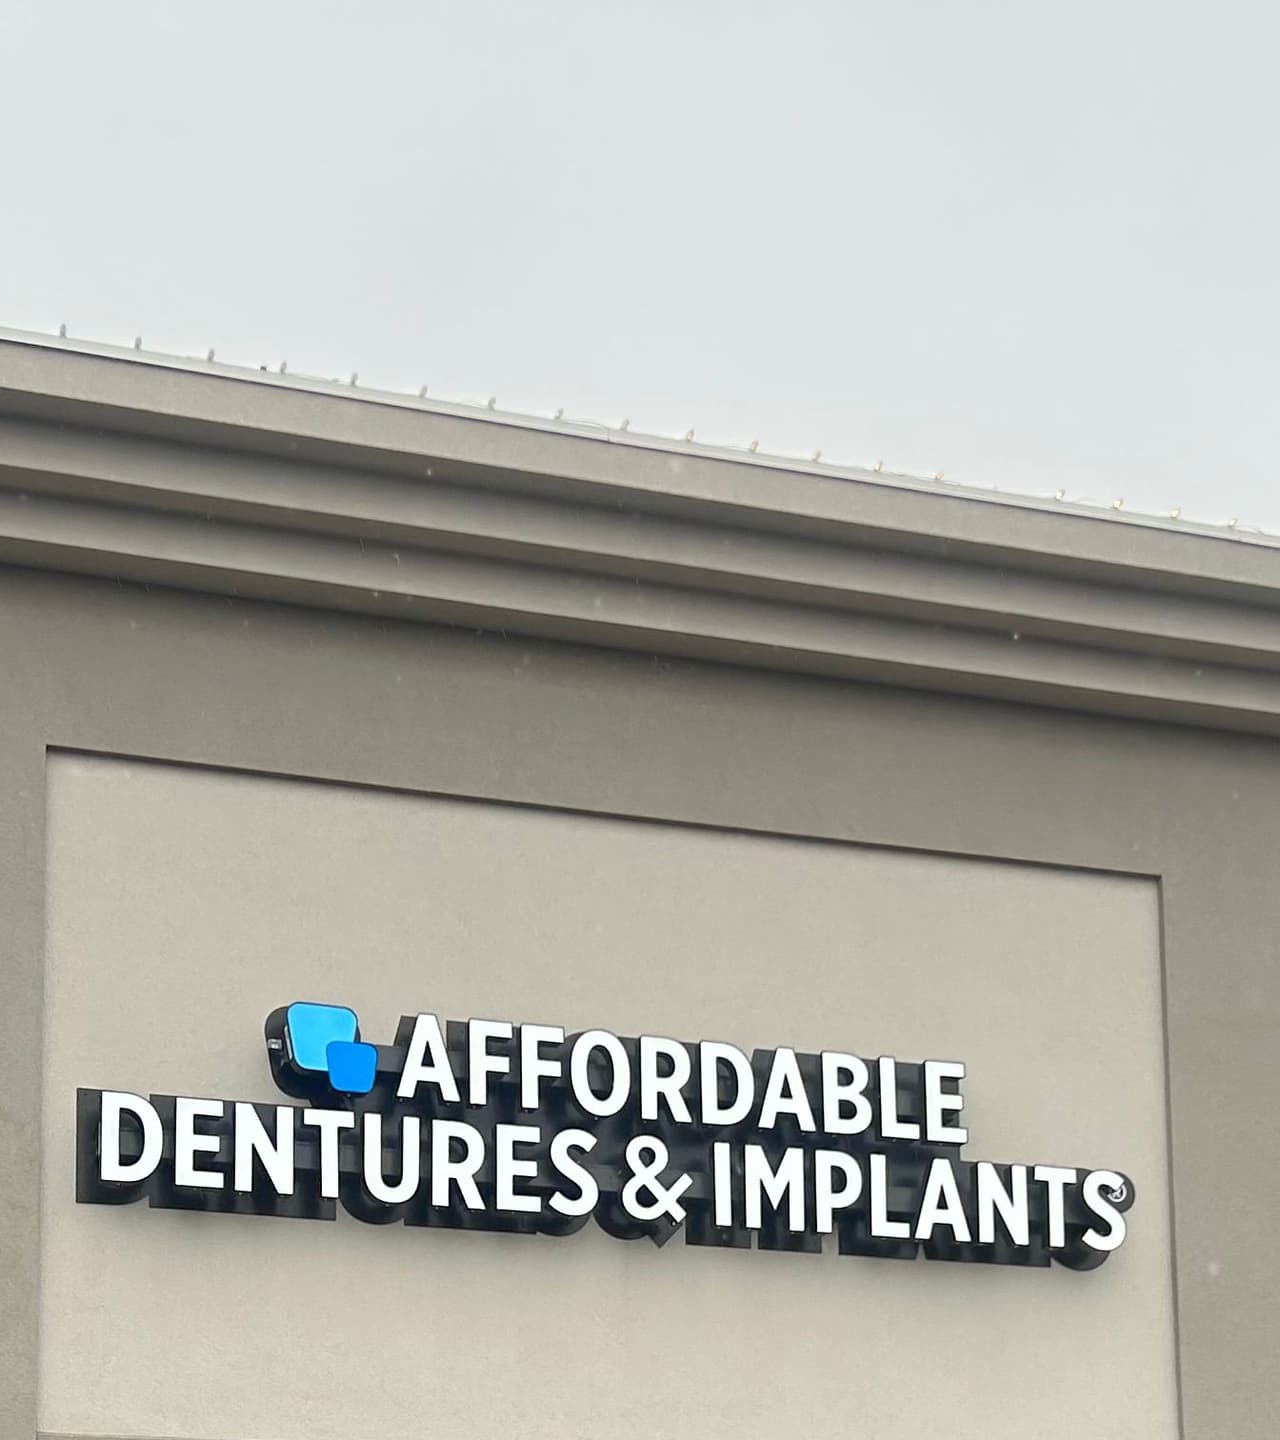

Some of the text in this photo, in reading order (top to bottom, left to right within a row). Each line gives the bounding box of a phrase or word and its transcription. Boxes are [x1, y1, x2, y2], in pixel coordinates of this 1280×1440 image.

[396, 1013, 968, 1144] AFFORDABLE
[98, 1090, 1128, 1252] DENTURES & IMPLANTS
